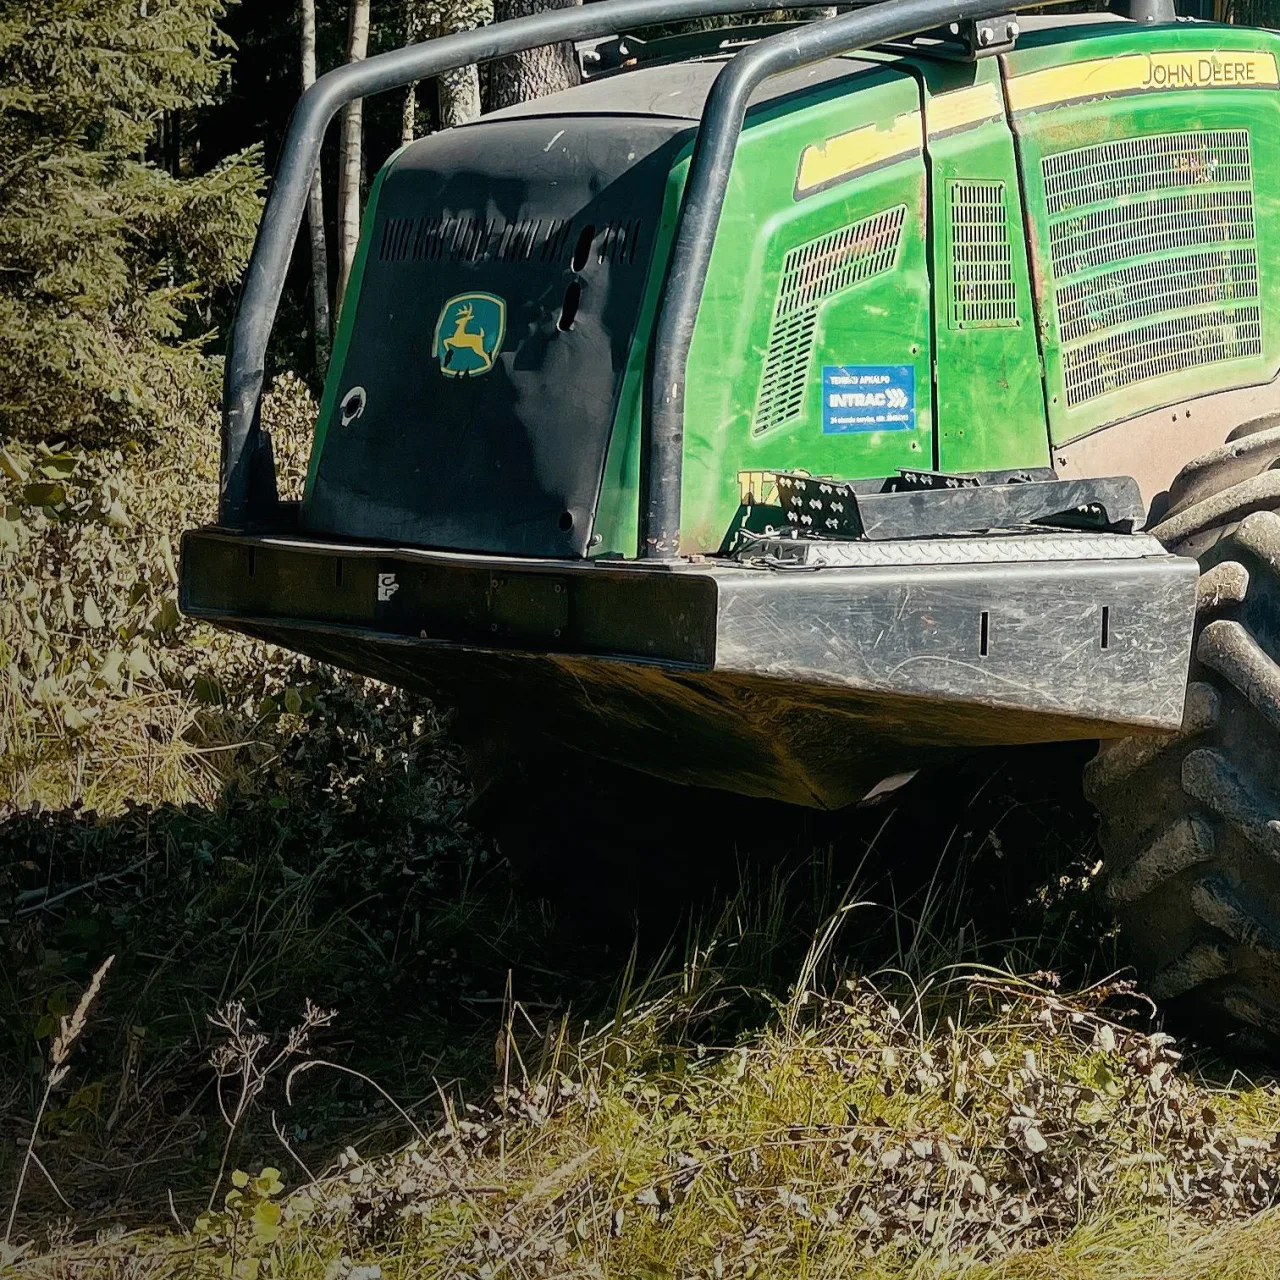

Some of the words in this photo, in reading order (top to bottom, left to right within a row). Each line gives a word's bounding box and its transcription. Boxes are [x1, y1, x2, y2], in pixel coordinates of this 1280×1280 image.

[1143, 60, 1193, 84] JOHN
[1198, 59, 1255, 81] DEERE
[829, 393, 886, 408] INTRAC
